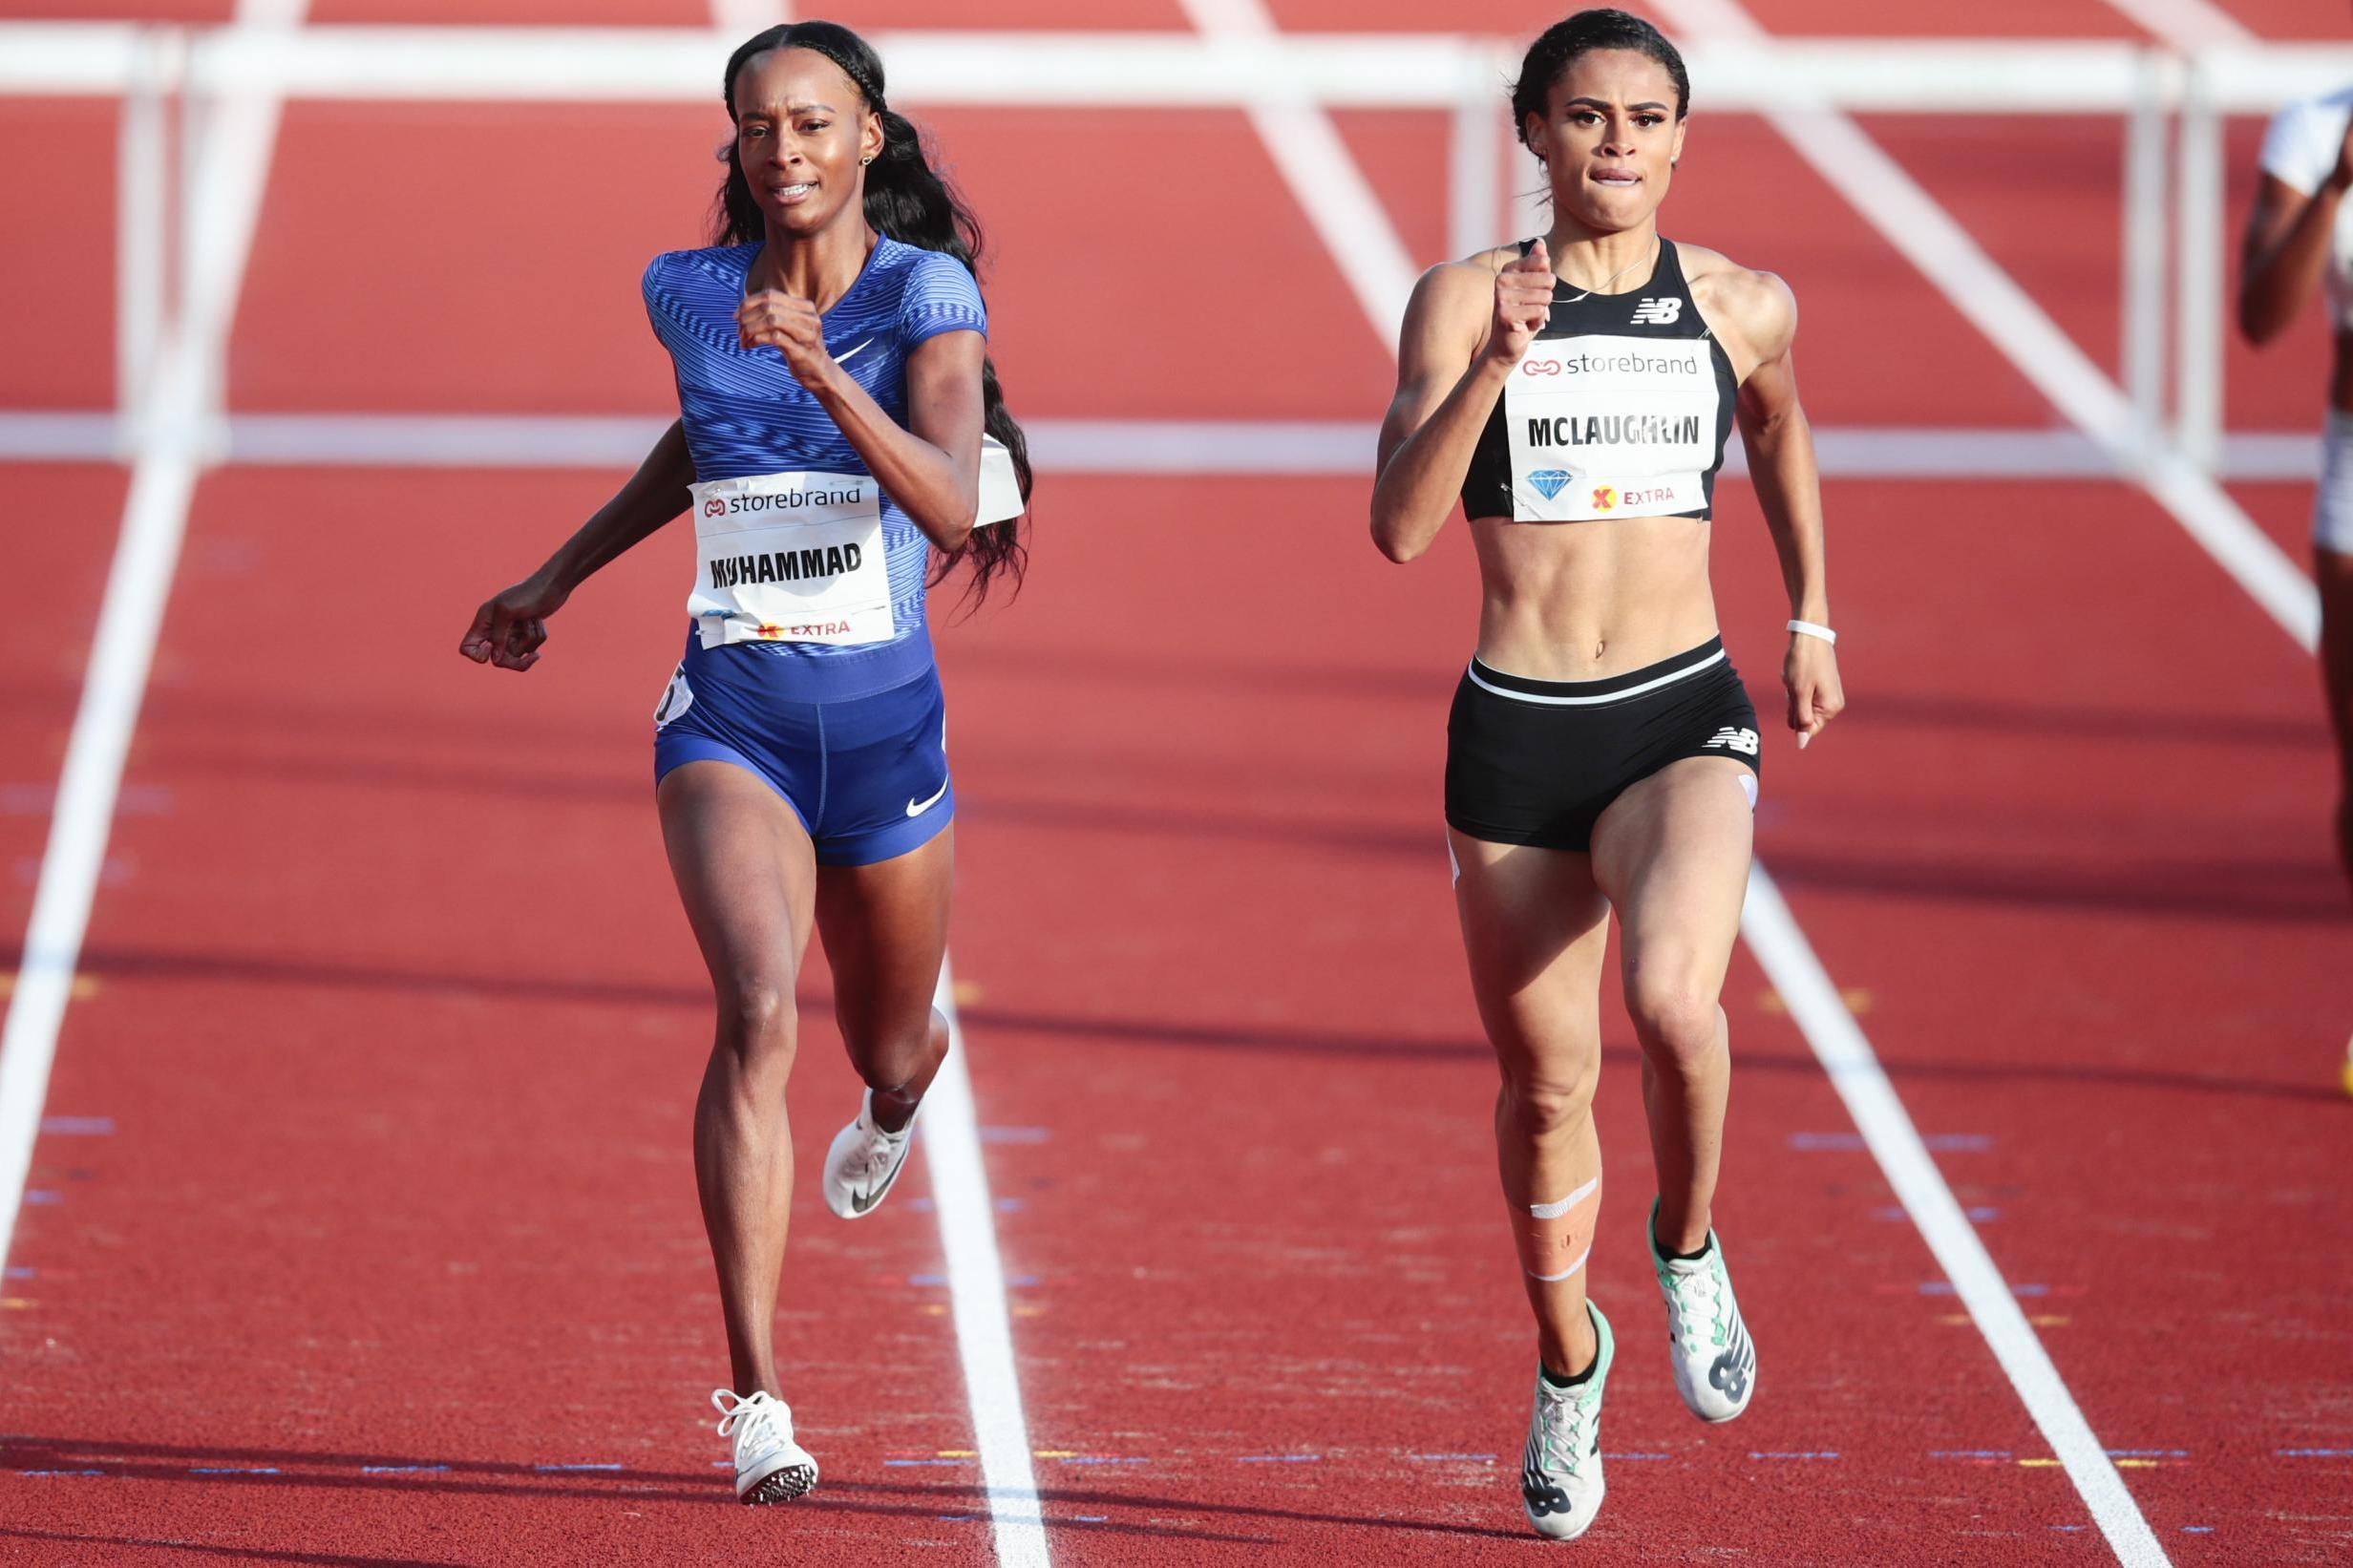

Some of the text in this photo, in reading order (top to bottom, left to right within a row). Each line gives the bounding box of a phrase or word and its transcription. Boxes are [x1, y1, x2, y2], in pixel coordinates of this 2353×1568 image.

[1567, 351, 1698, 375] storebrand
[1528, 414, 1699, 447] MCLAUGHLIN
[730, 488, 860, 514] storebrand
[1623, 487, 1675, 506] EXTRA
[710, 542, 862, 589] MUHAMMAD
[790, 620, 850, 636] EXTRA
